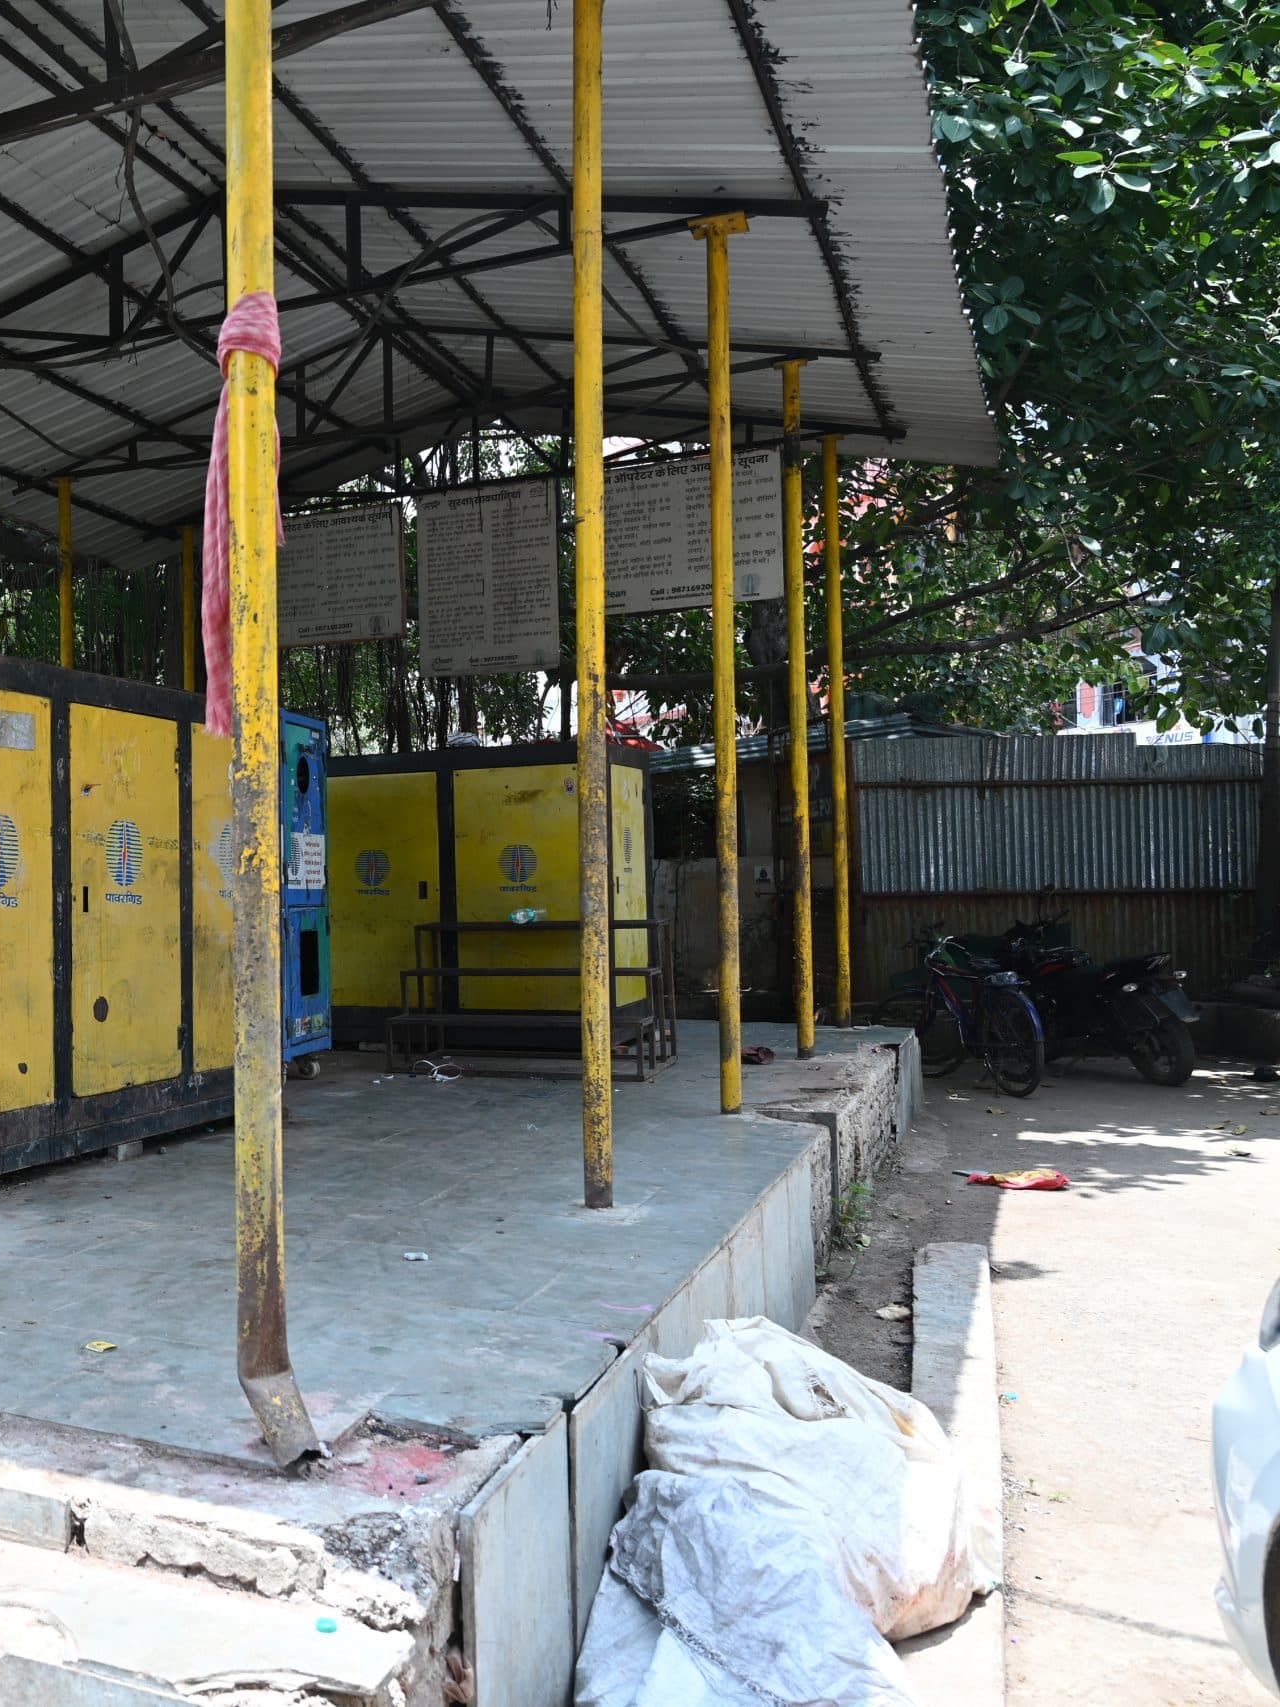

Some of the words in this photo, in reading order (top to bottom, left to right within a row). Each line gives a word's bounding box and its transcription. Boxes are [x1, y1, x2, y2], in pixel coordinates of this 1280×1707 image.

[738, 454, 769, 469] सूचना
[654, 467, 666, 477] के
[667, 464, 689, 476] लिए
[650, 587, 665, 596] Call
[671, 583, 713, 594] 98716920
[1146, 731, 1194, 744] VENUS
[105, 890, 142, 905] पावरग्रिड
